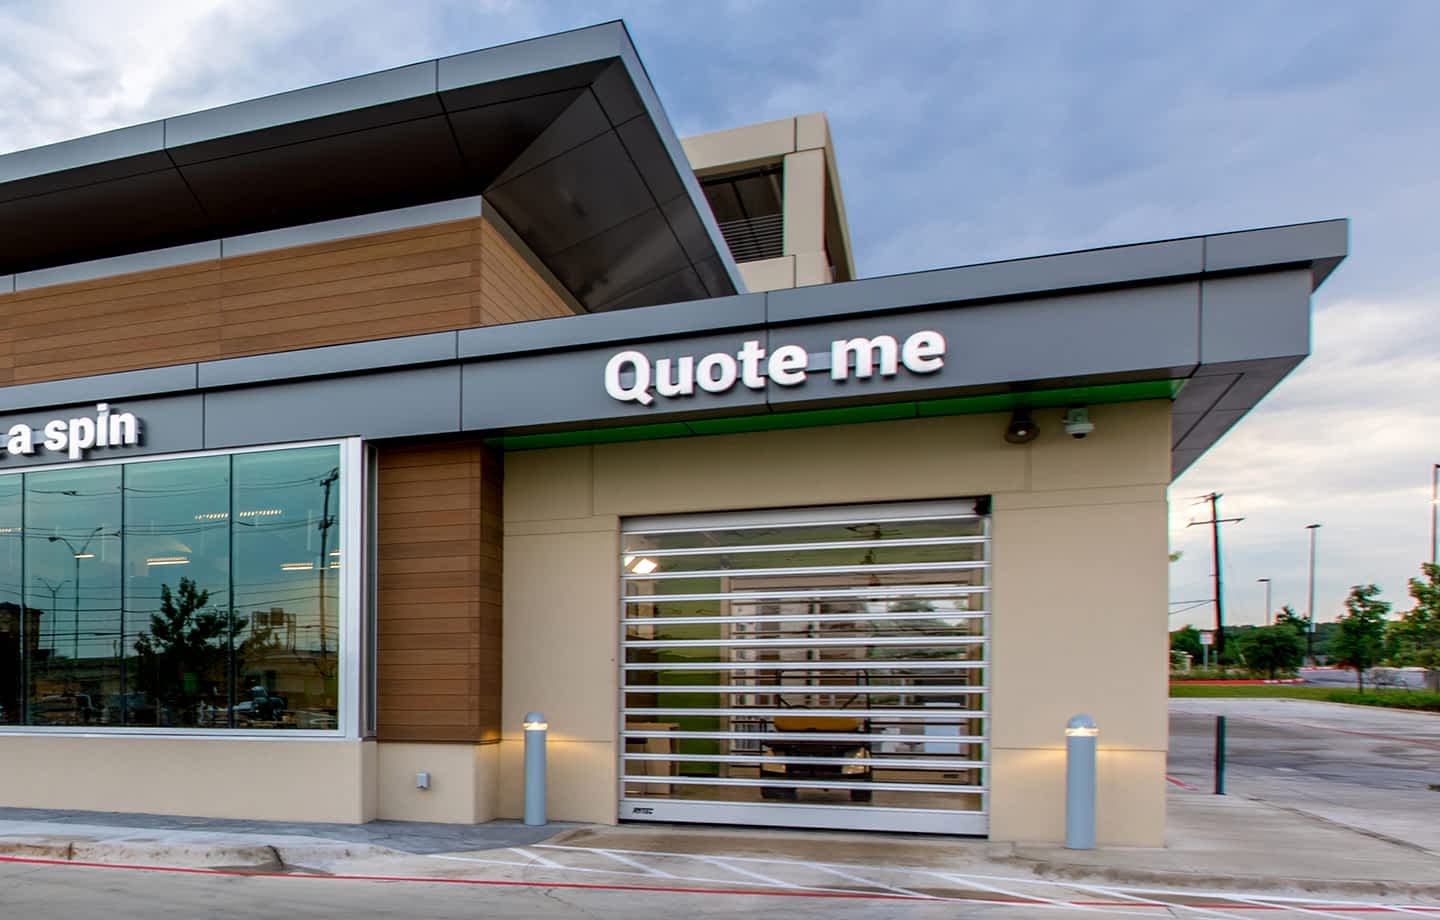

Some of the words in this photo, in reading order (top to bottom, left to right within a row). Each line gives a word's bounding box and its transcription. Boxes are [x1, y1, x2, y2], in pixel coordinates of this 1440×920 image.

[605, 340, 808, 405] Quote
[831, 331, 946, 381] me
[8, 424, 35, 455] a
[44, 403, 140, 460] spin
